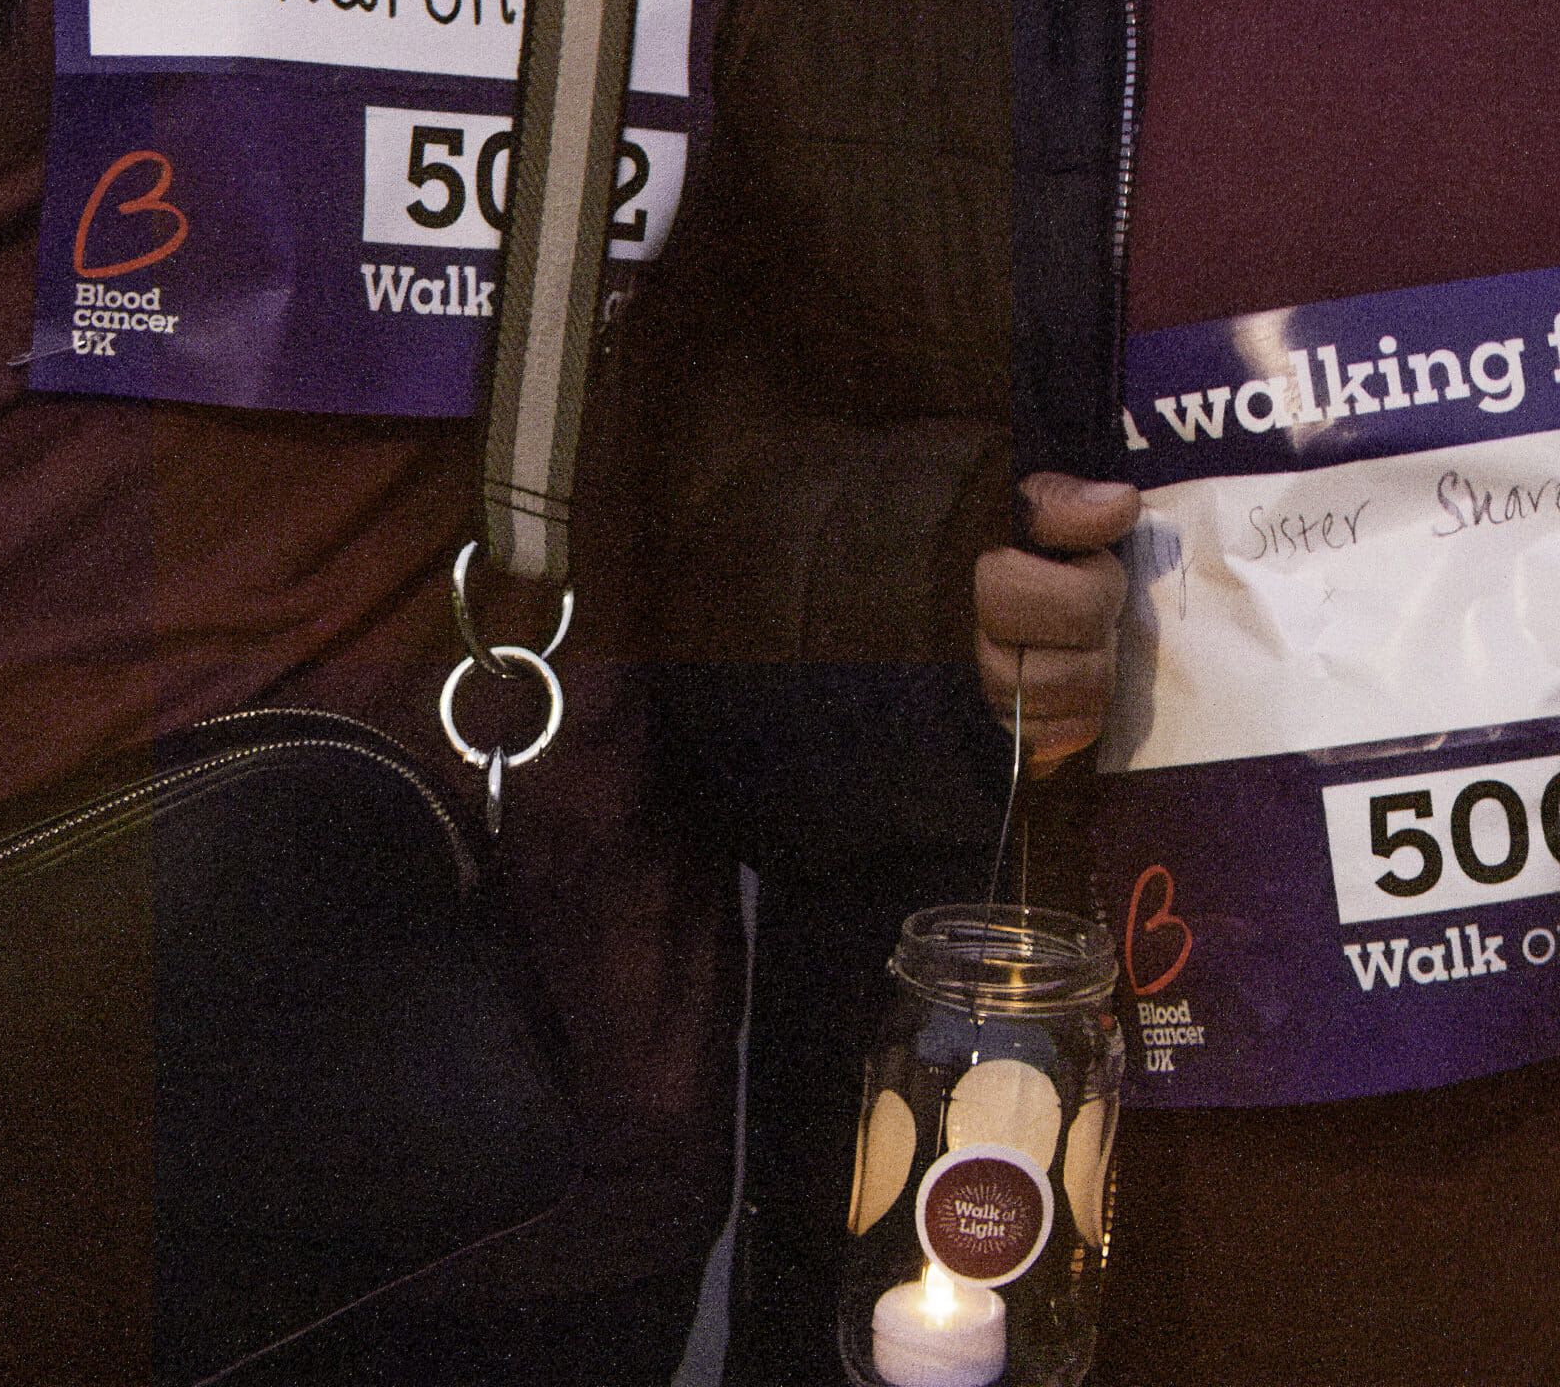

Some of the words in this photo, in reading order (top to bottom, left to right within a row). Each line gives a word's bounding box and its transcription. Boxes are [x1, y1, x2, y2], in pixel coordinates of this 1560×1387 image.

[406, 125, 651, 243] 502
[74, 283, 161, 311] Blood
[361, 263, 495, 316] Walk
[73, 308, 179, 334] cancer
[72, 330, 117, 356] UK
[1154, 334, 1524, 444] walking
[1248, 499, 1371, 561] Sister
[1344, 924, 1506, 992] Walk
[1137, 999, 1191, 1025] Blood
[1142, 1026, 1206, 1047] cancer
[1146, 1049, 1175, 1072] UK
[954, 1199, 1000, 1221] Walk
[959, 1217, 1005, 1240] Light
